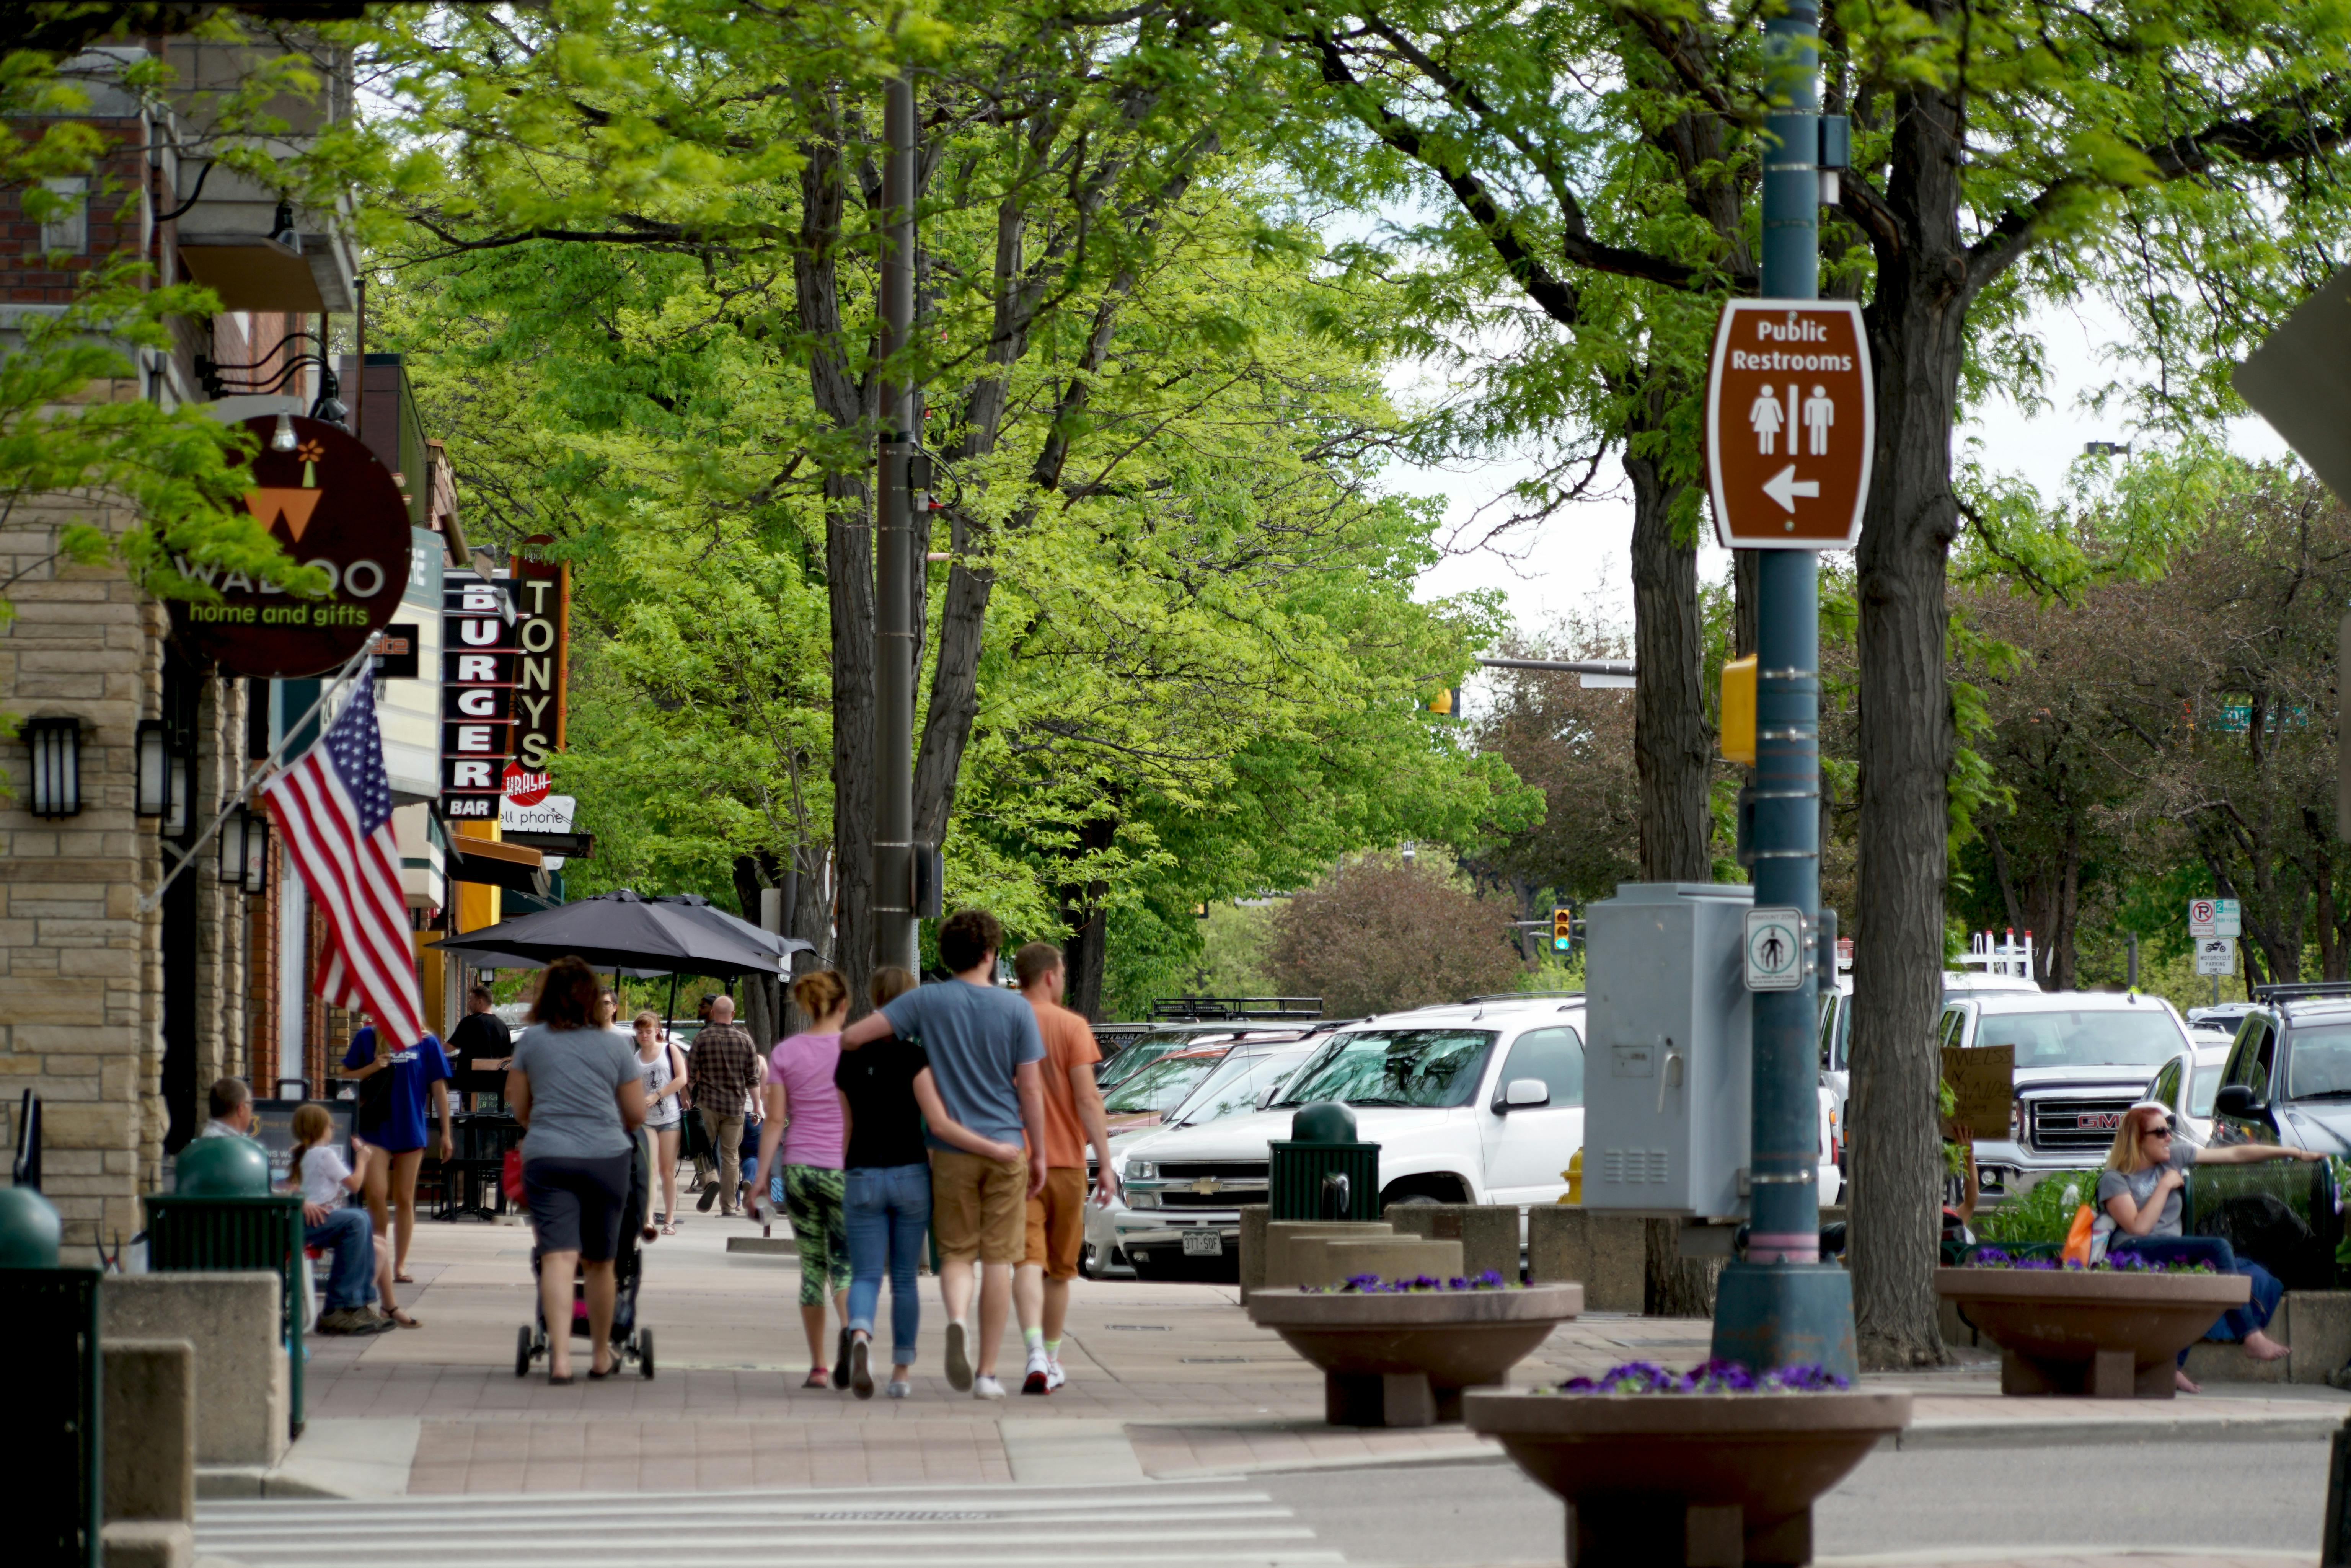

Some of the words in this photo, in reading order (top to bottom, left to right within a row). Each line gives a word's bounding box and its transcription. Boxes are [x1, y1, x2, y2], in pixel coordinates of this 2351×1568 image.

[1758, 320, 1827, 341] Public
[1733, 350, 1852, 371] Restrooms
[190, 603, 256, 623] home
[262, 605, 307, 624] and
[313, 605, 368, 626] gifts
[521, 581, 554, 768] TONYS
[454, 585, 499, 787] BURGER
[450, 800, 489, 815] BAR
[520, 811, 563, 826] phone
[2078, 1114, 2124, 1128] GM
